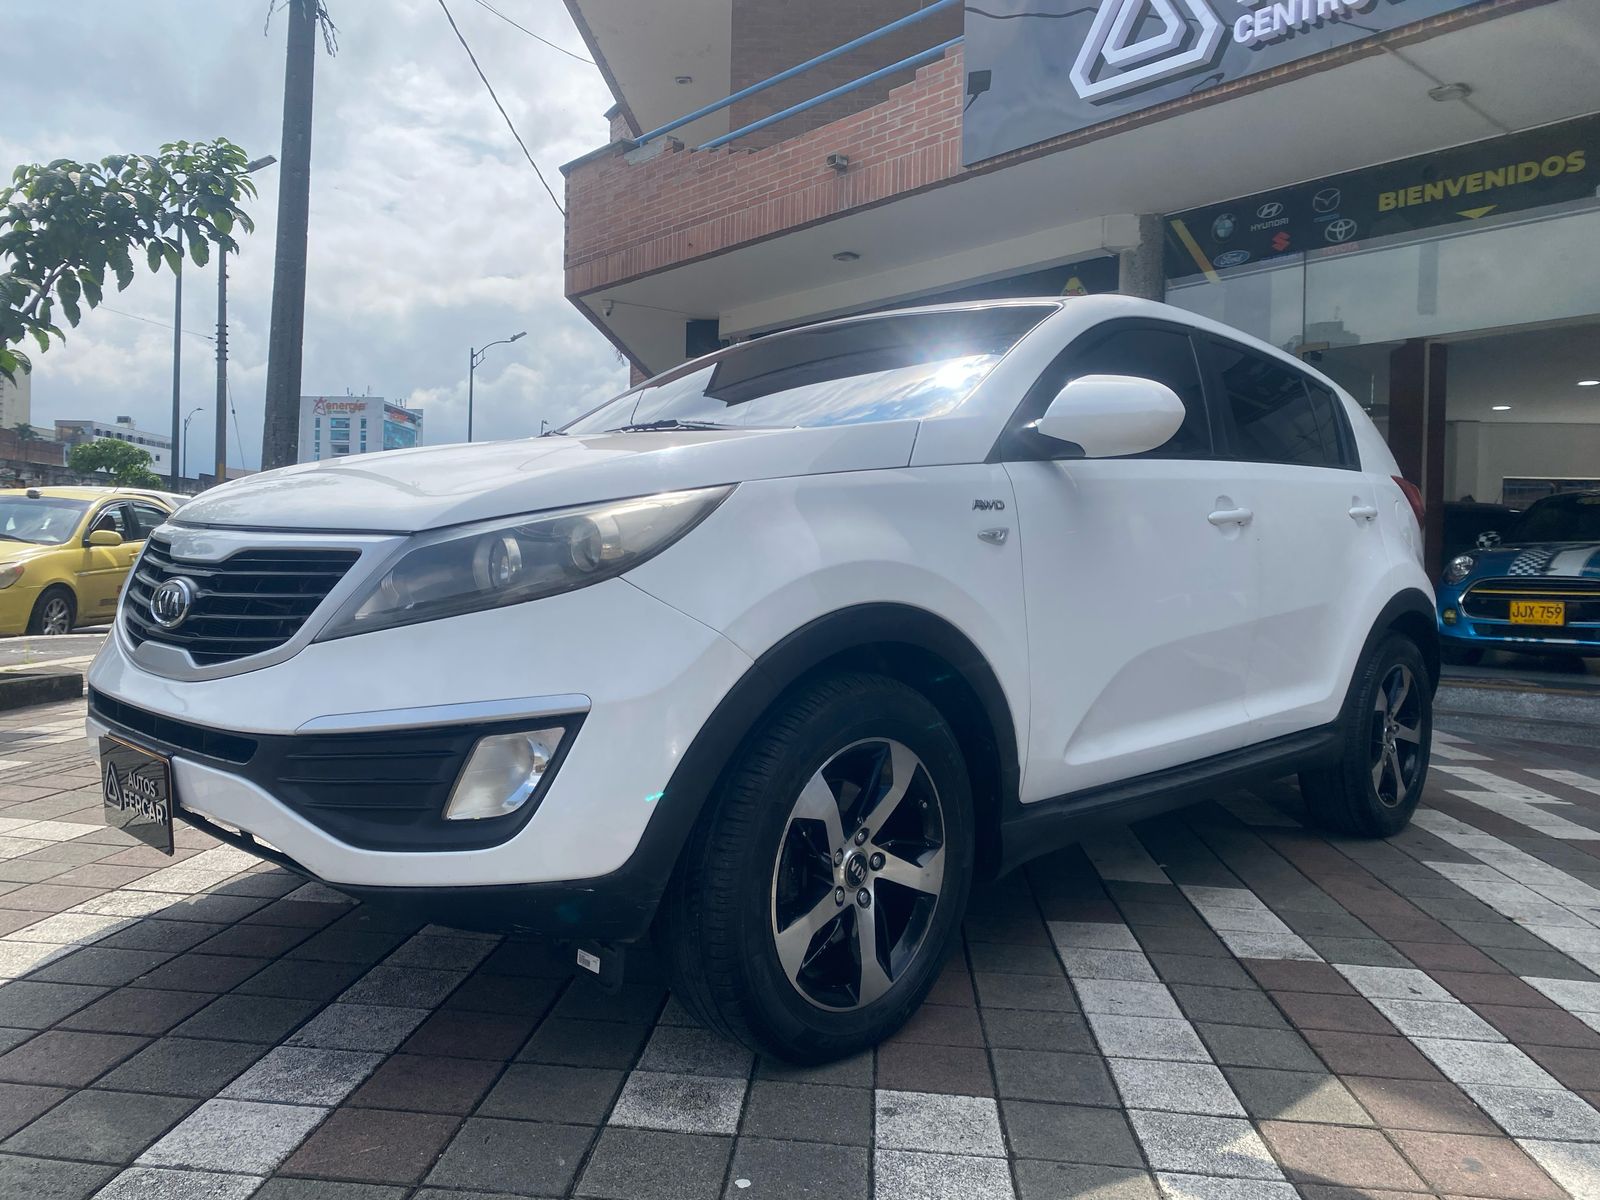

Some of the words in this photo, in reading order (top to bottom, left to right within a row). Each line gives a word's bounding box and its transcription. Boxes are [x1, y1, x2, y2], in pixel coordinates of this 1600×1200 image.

[1233, 0, 1366, 45] CENT
[1377, 150, 1586, 212] BIENVENIDOS
[1250, 217, 1289, 232] HYUNDAI
[972, 499, 1005, 511] AWD
[1512, 605, 1535, 618] JJX
[1539, 606, 1563, 619] 759
[127, 771, 156, 798] AUTOS
[123, 789, 164, 826] FERCAR
[850, 859, 867, 882] KIA
